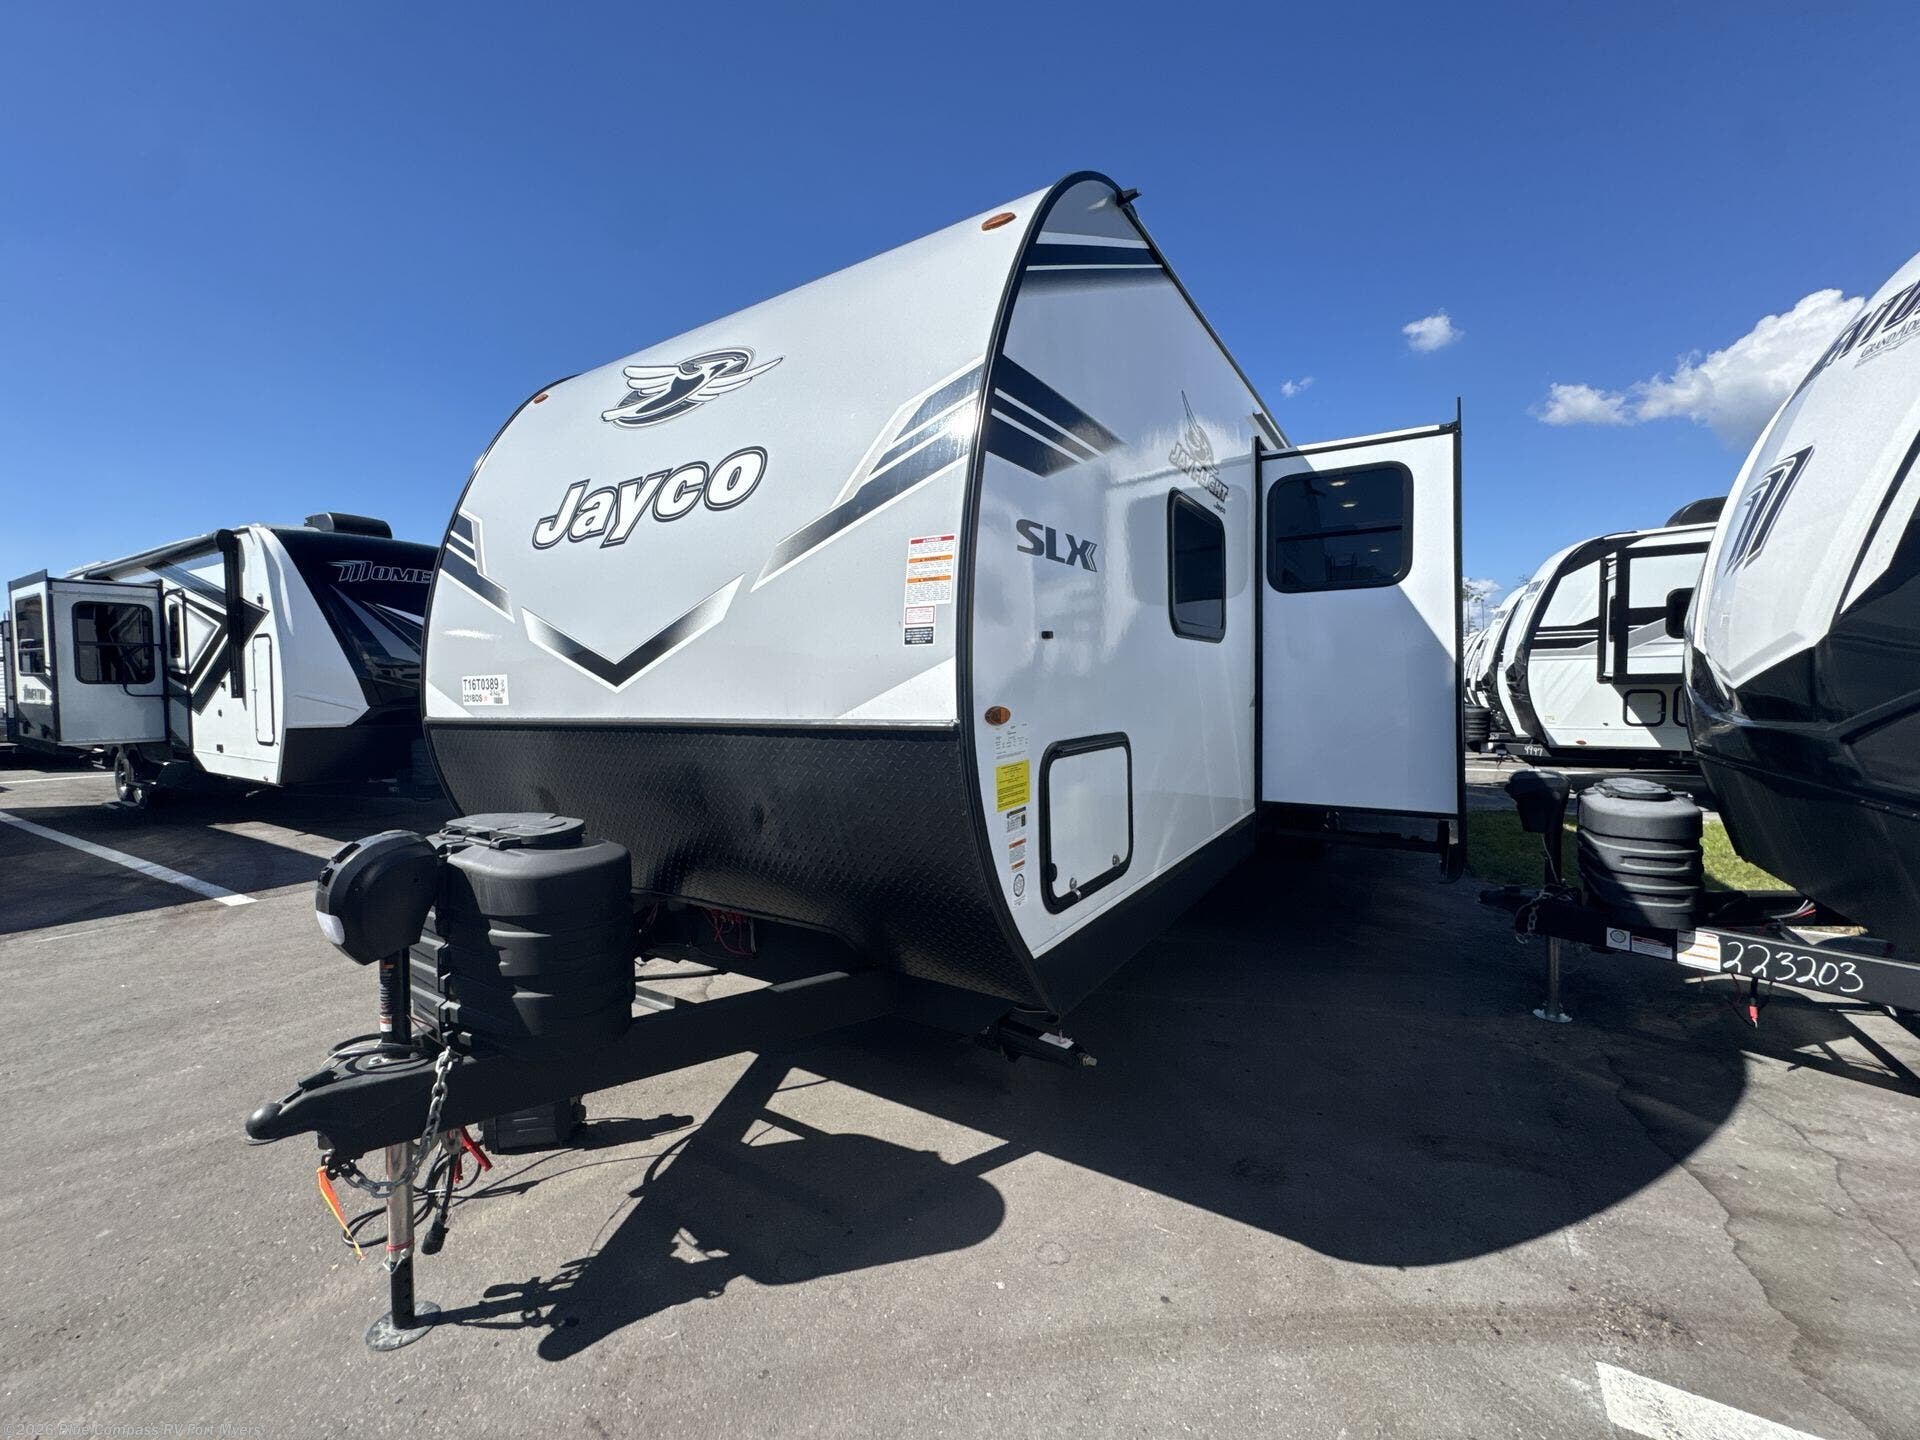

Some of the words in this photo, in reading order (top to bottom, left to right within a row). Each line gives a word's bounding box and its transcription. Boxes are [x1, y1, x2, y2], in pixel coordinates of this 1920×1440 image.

[532, 446, 768, 550] Jayco
[1016, 519, 1097, 573] SLX
[463, 677, 499, 691] T16T0389
[1723, 942, 1864, 992] 223203
